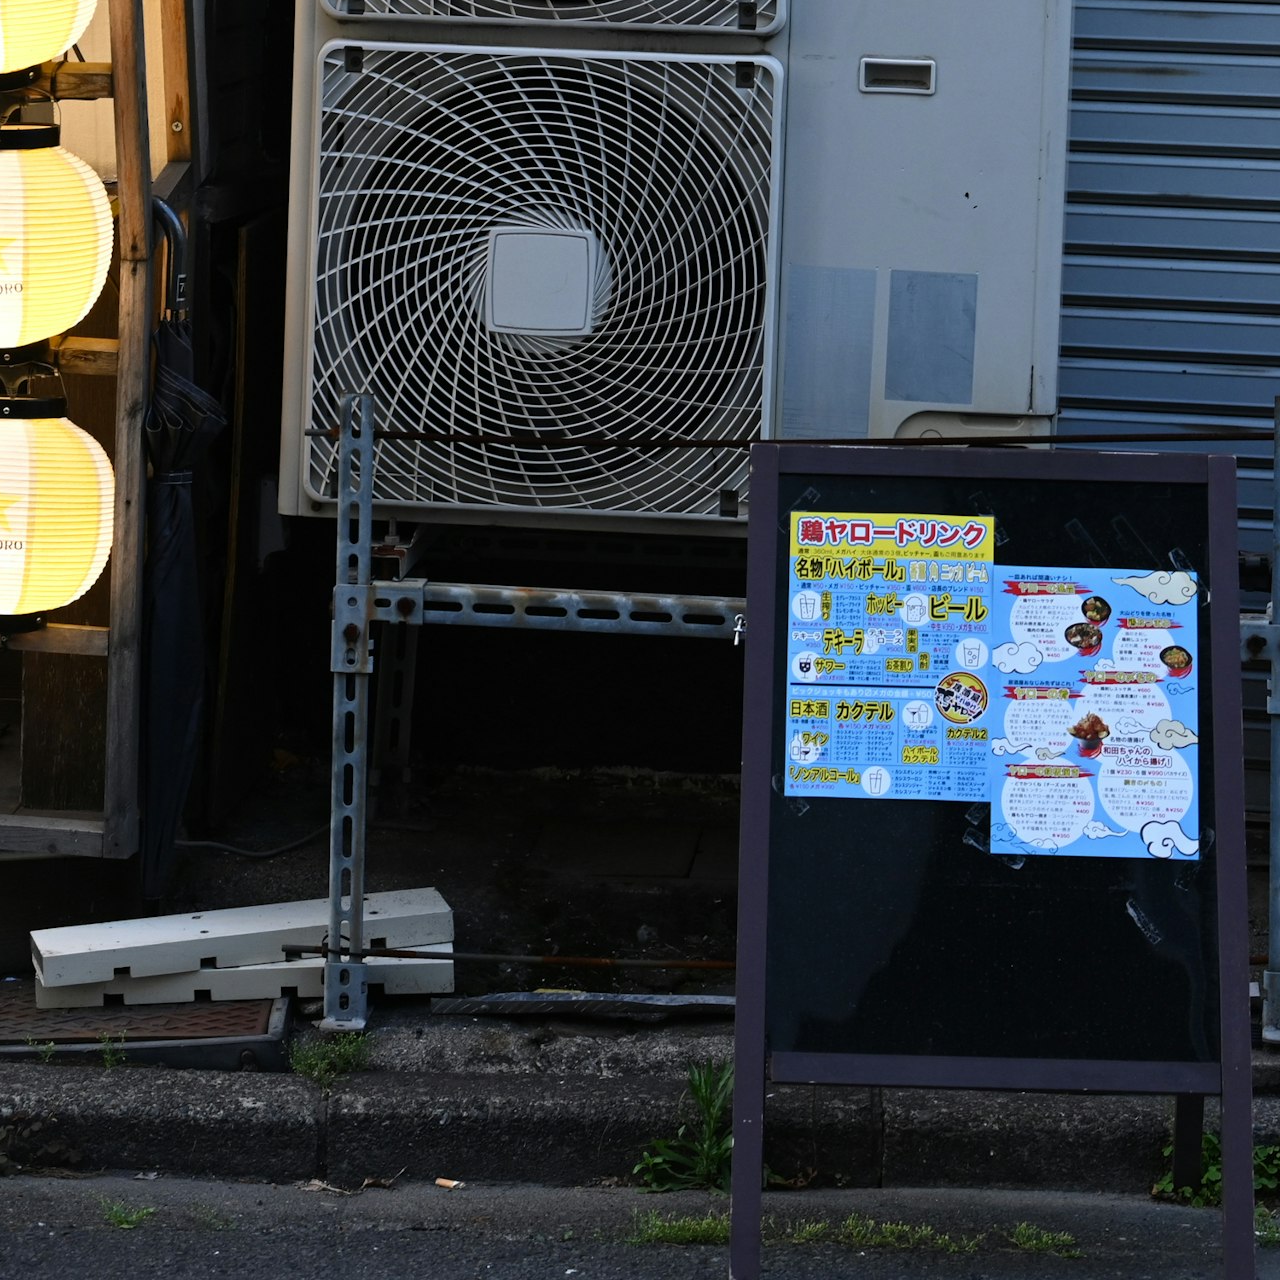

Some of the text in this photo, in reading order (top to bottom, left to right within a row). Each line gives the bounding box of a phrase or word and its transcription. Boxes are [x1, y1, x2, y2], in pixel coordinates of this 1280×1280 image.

[798, 518, 986, 548] 鶏ヤロードリンク
[795, 557, 905, 581] 名物「ハイボール」
[867, 592, 903, 614] ホッピー
[929, 592, 987, 621] ビール
[823, 628, 863, 655] テキーラ
[814, 658, 846, 675] サワー
[790, 700, 829, 718] 日本酒
[836, 700, 895, 721] カクテル
[803, 731, 829, 746] ワイン
[946, 727, 988, 740] カクテル2
[903, 755, 938, 763] カクテル
[1103, 746, 1151, 756] 和田ちゃんの
